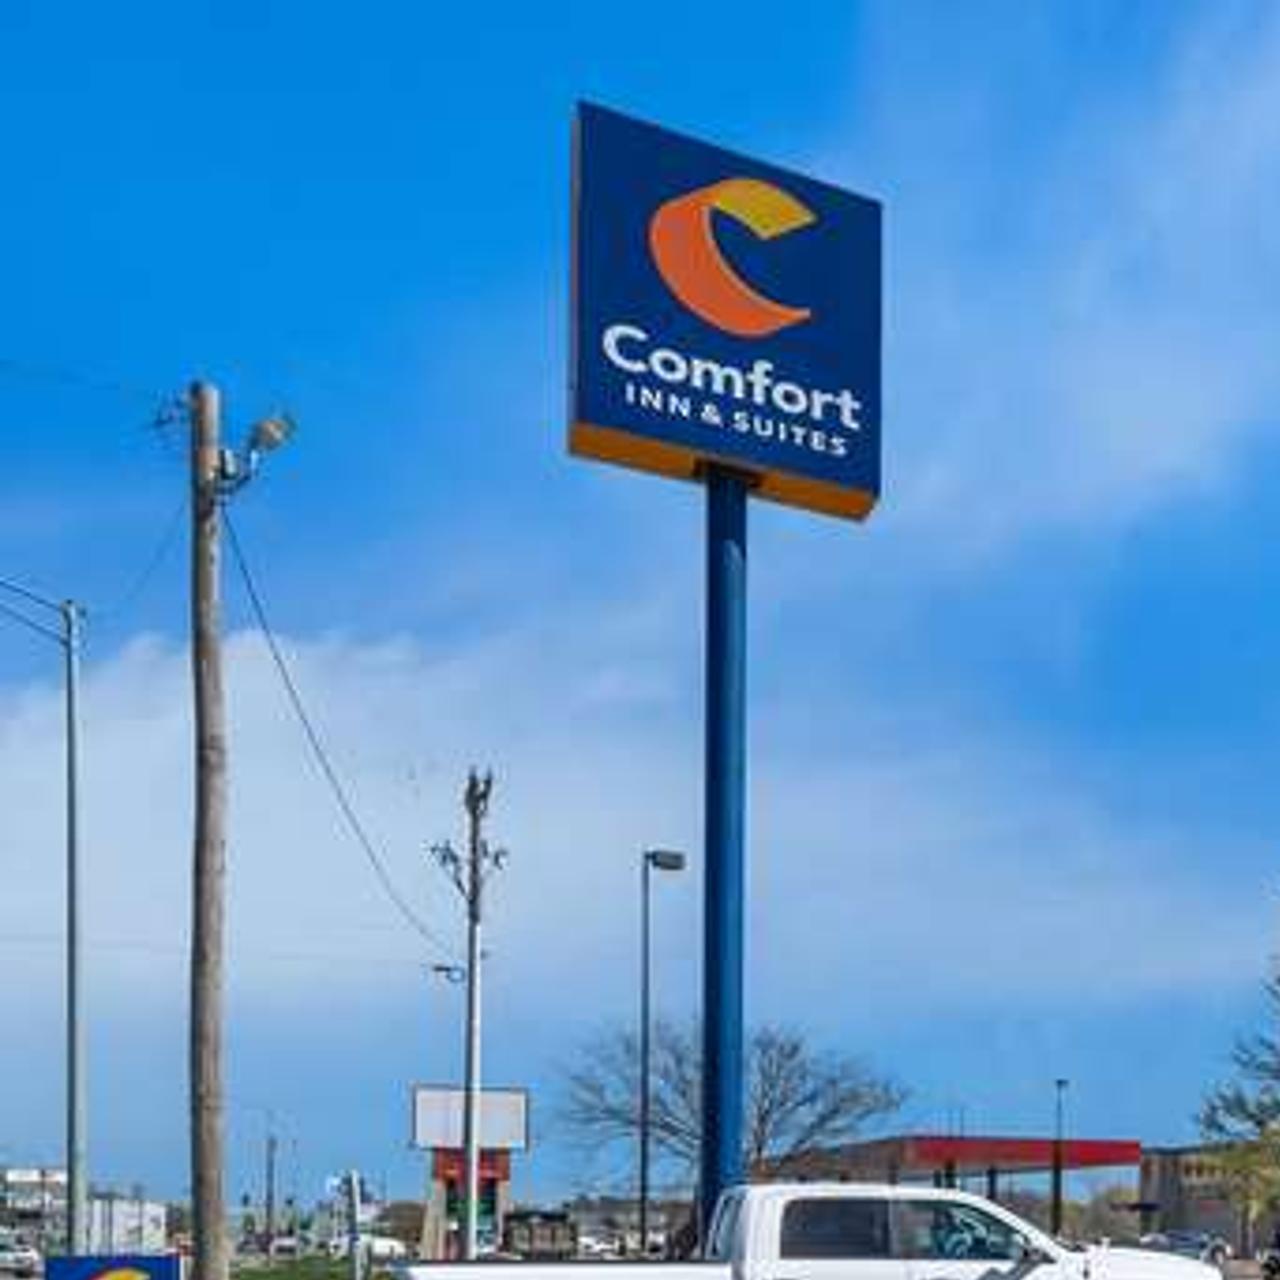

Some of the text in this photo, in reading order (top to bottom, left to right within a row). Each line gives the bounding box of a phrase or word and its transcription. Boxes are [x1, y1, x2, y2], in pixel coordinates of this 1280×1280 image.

[602, 324, 861, 430] Comfort
[625, 382, 848, 456] INN & SUITES
